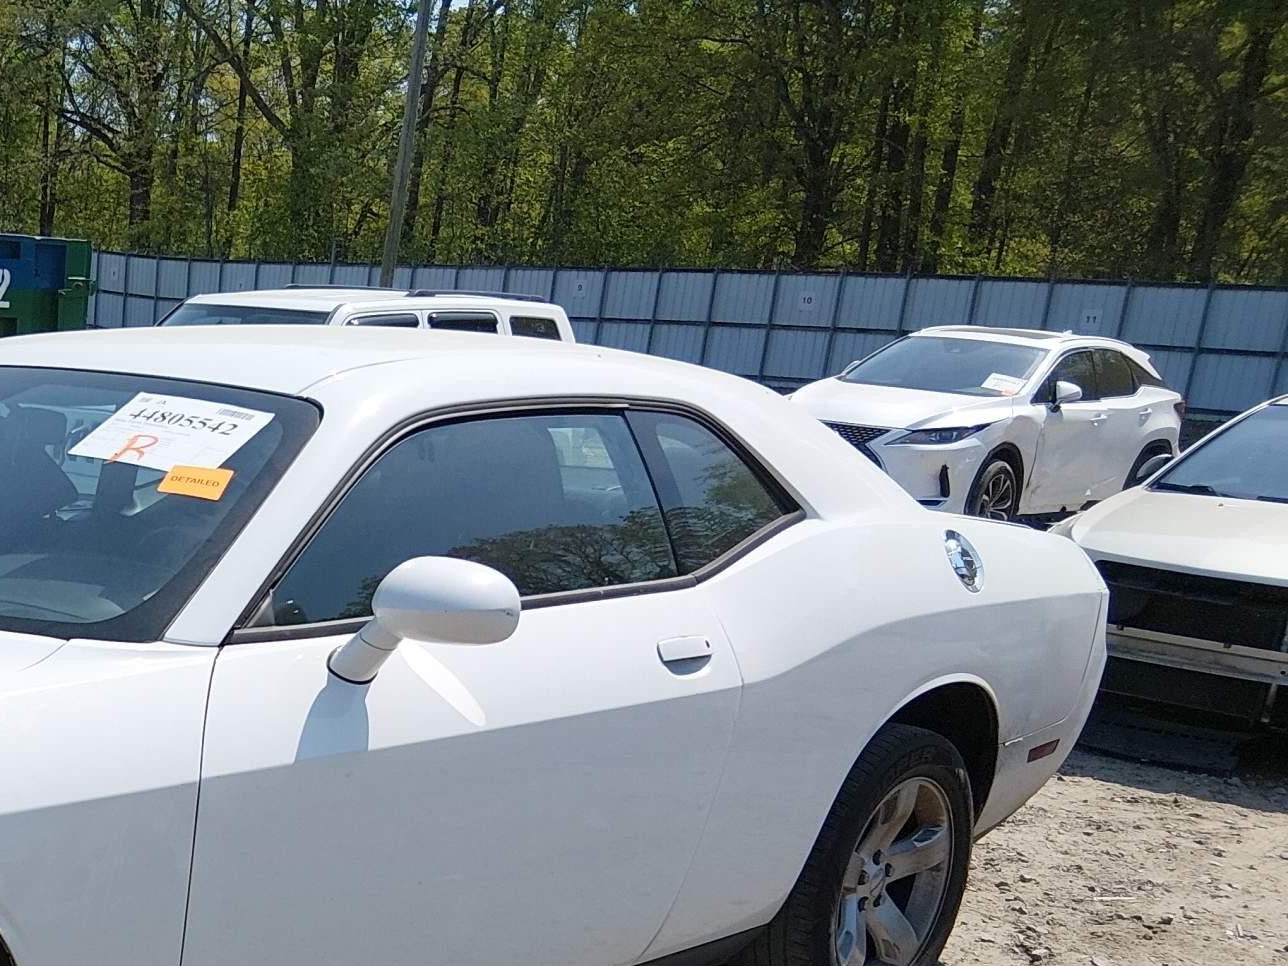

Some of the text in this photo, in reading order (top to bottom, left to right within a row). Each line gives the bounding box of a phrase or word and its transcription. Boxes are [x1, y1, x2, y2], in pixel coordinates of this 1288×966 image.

[802, 296, 813, 305] 10
[129, 408, 239, 435] 44805542
[170, 474, 220, 488] DETAILED
